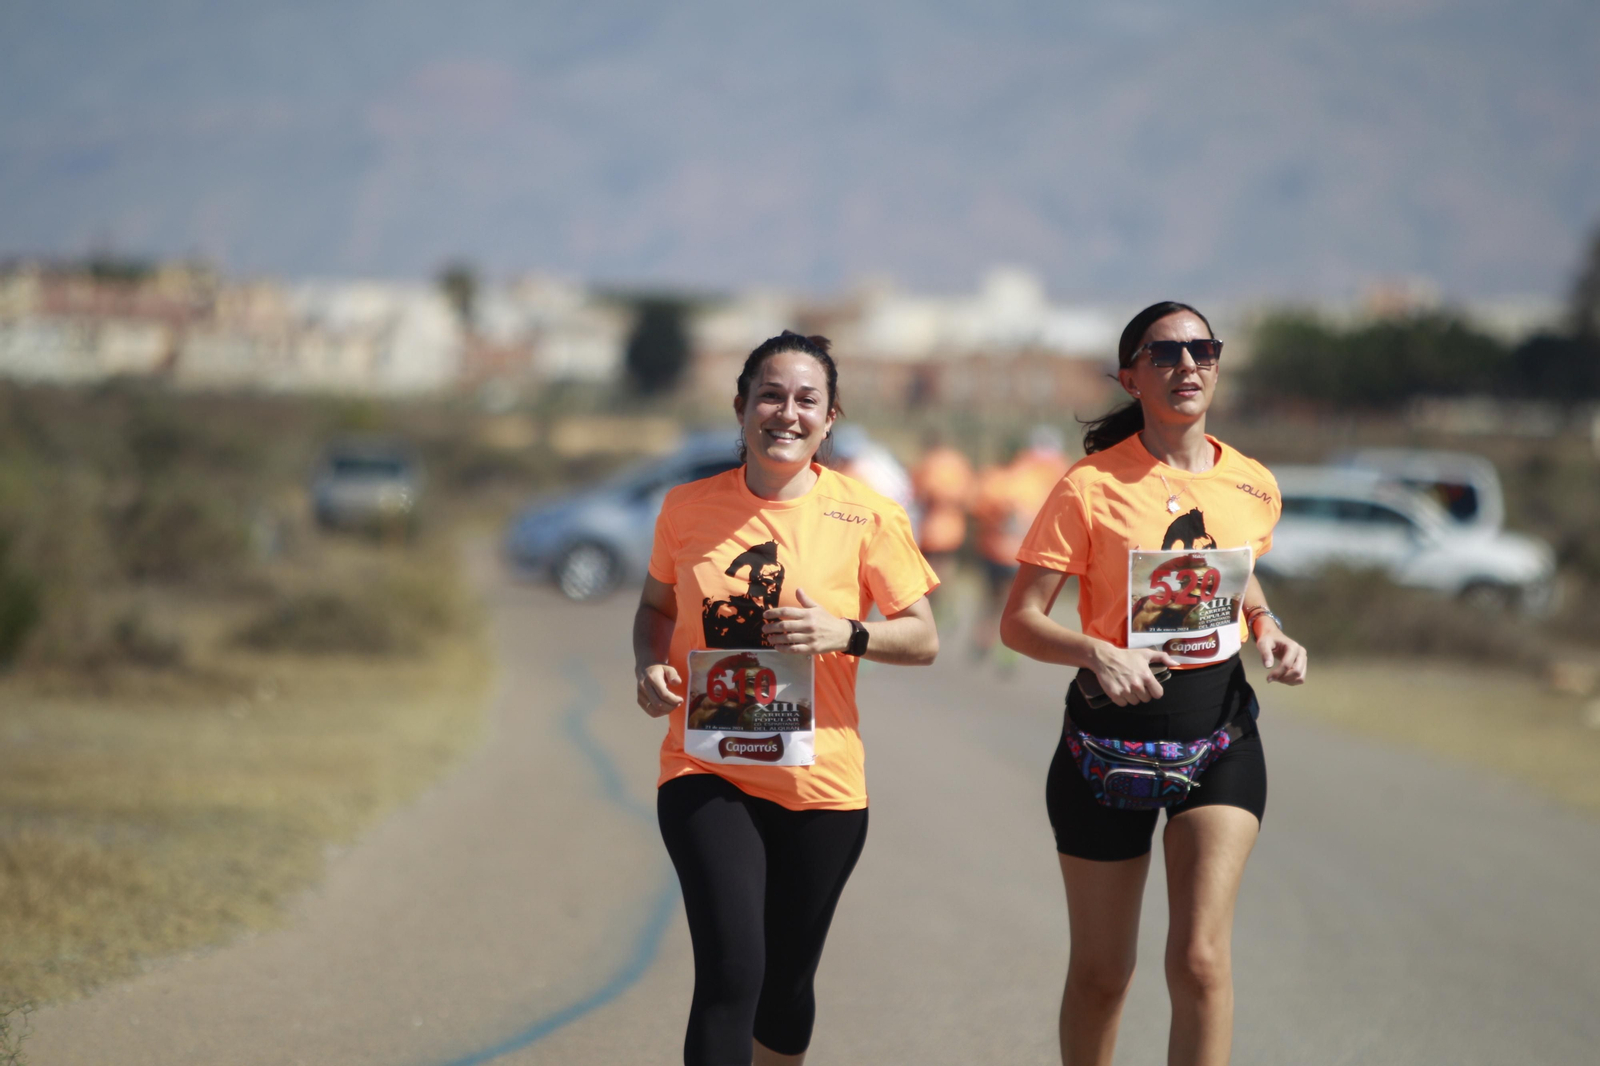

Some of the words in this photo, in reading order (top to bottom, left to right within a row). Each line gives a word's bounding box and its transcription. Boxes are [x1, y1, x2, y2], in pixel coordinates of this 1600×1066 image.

[1149, 568, 1221, 605] 520
[1199, 598, 1232, 611] XIII
[1199, 606, 1231, 616] CARRERA
[1199, 611, 1231, 621] POPULAR
[707, 667, 777, 704] 610
[754, 702, 799, 712] XIII
